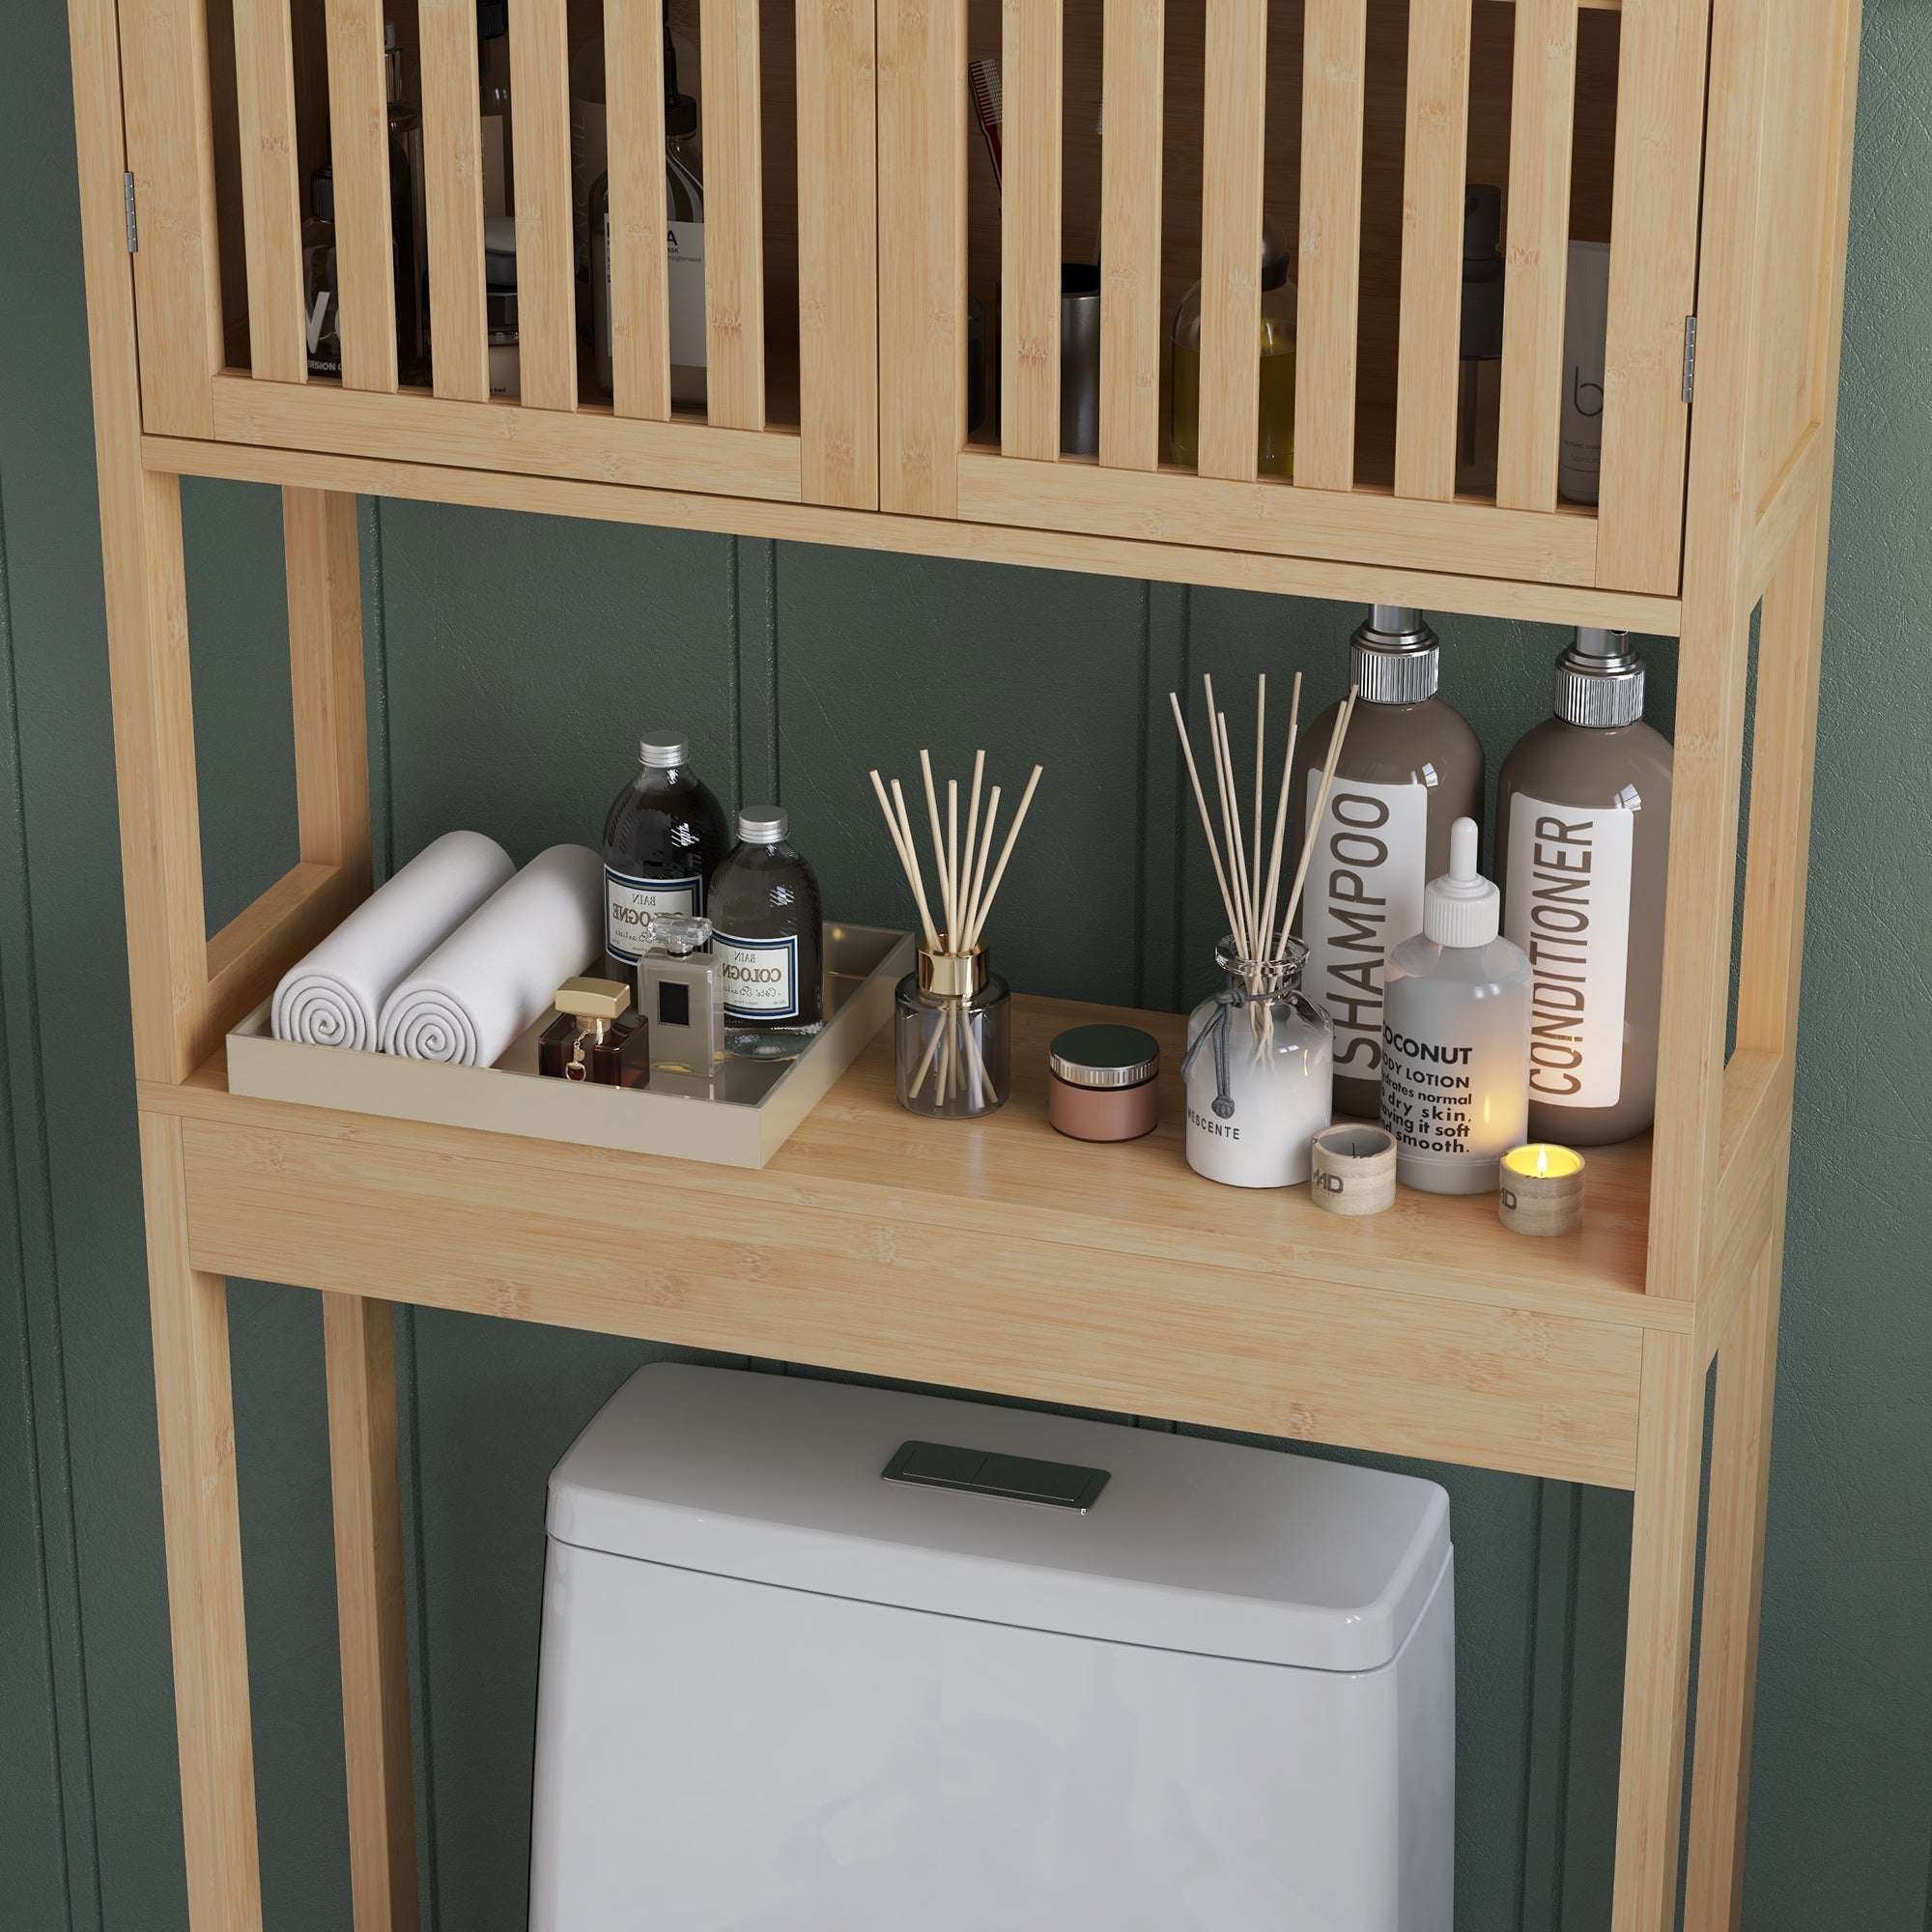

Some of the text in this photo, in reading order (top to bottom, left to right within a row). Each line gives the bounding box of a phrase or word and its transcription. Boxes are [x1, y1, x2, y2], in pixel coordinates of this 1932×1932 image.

[1326, 792, 1390, 1070] SHAMPOO
[1528, 816, 1593, 1094] CONDITIONER
[1382, 1053, 1469, 1089] ODY LOTION
[1388, 1092, 1413, 1117] dry
[1418, 1092, 1472, 1105] normal
[1381, 1105, 1470, 1137] aving it soft
[1396, 1129, 1469, 1153] smooth.
